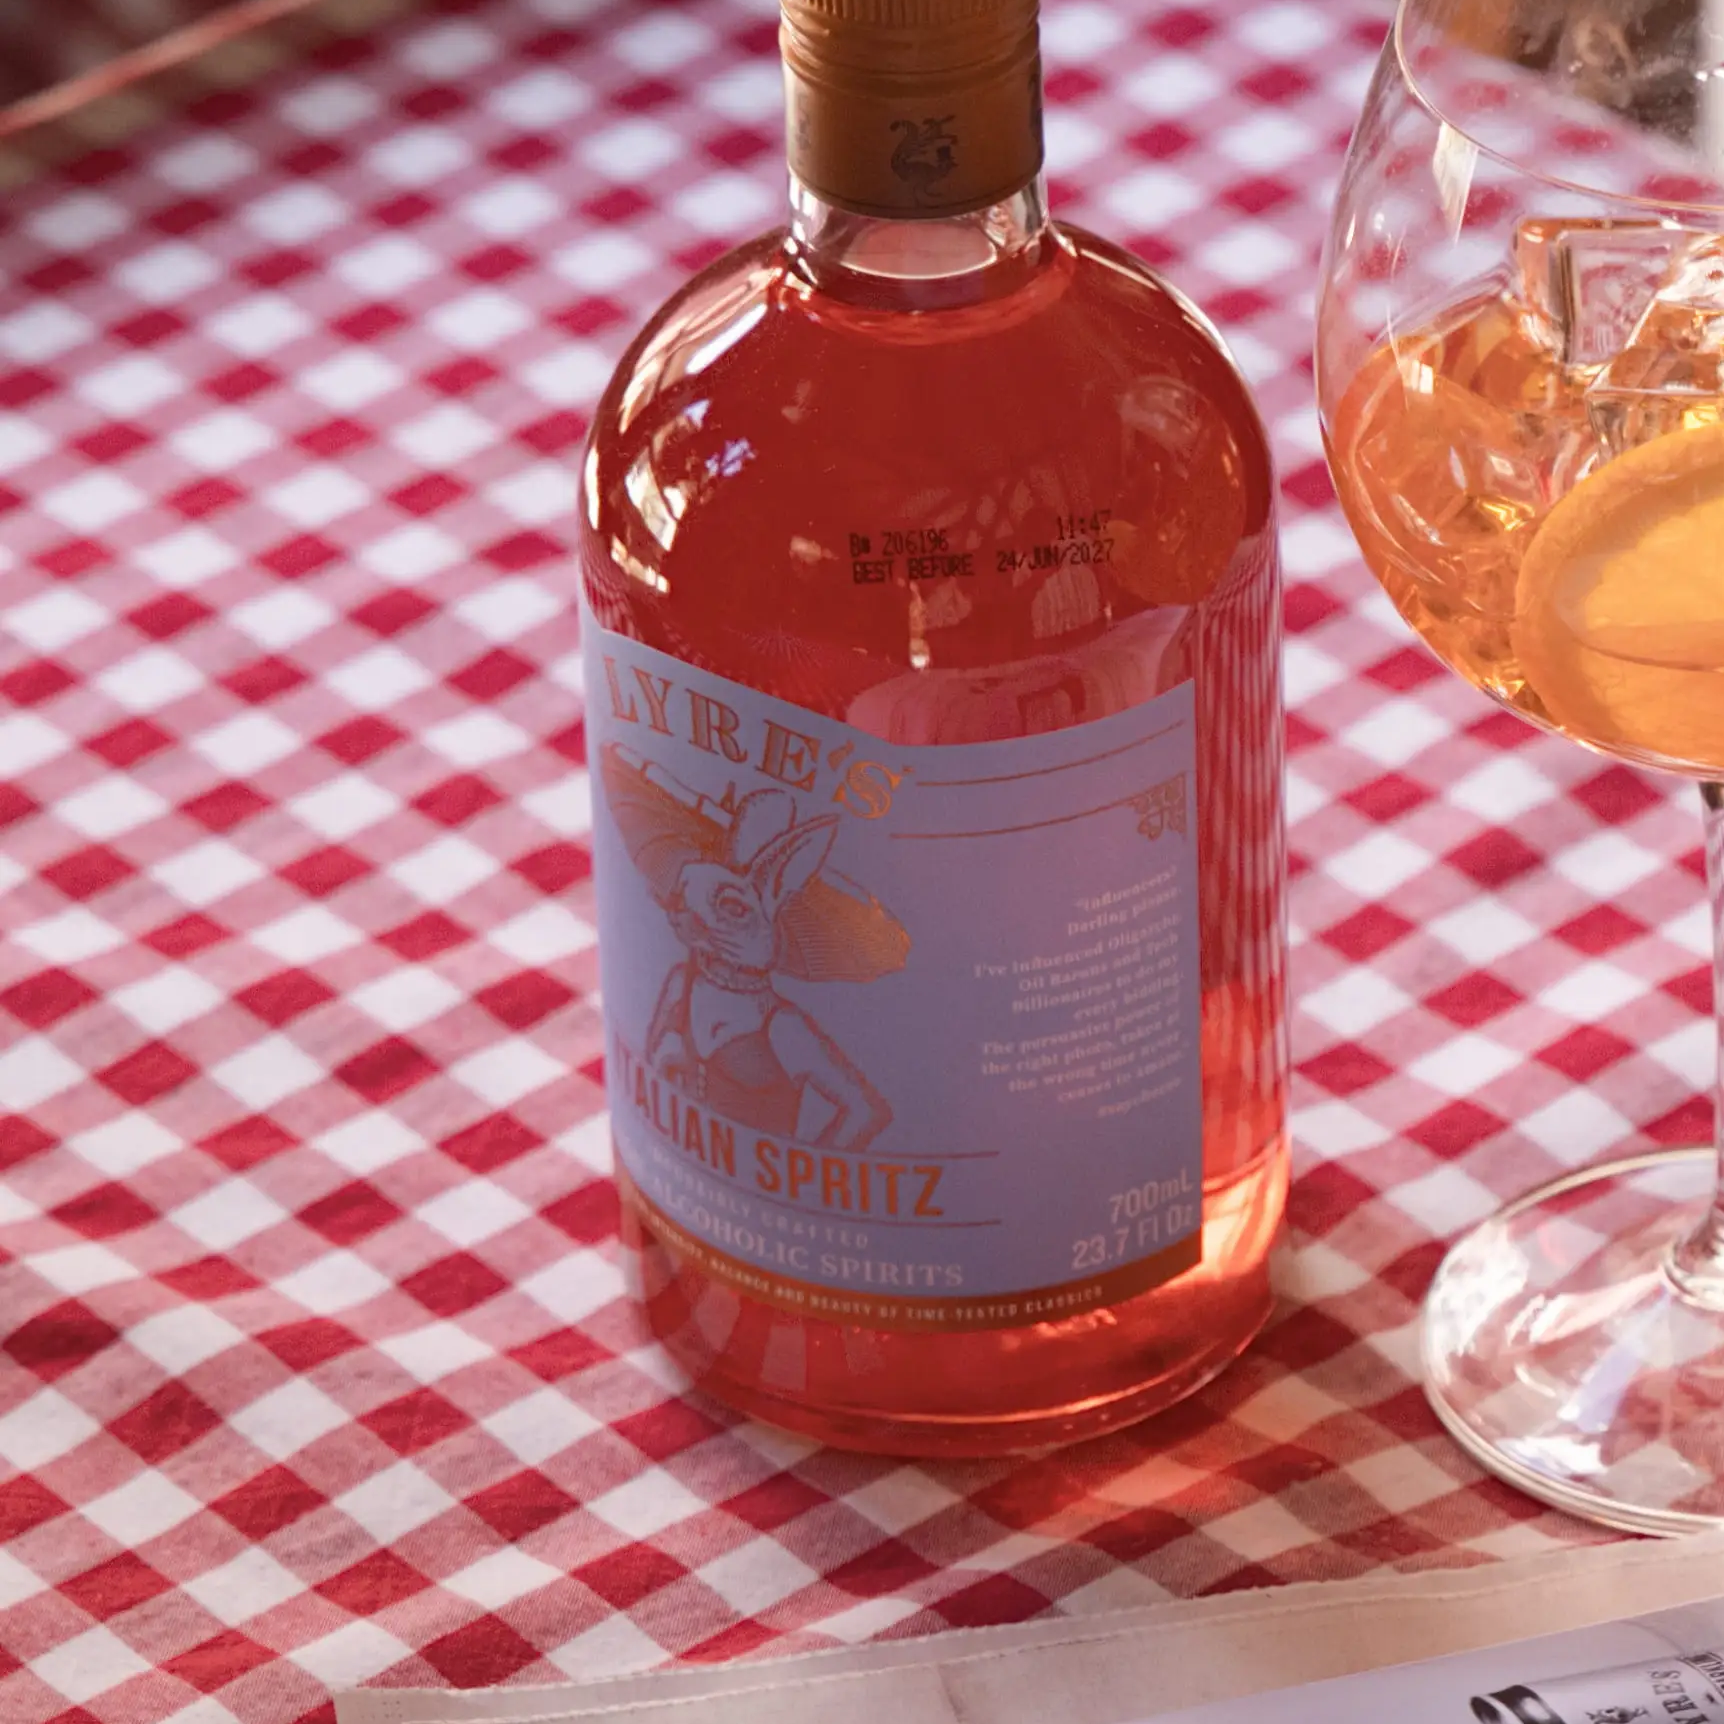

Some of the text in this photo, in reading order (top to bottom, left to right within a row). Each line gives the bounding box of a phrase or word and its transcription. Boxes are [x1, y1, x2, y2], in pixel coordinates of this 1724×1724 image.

[853, 560, 895, 585] BEST
[907, 553, 975, 580] BEFORE
[602, 654, 902, 821] LYRE'S
[755, 1139, 945, 1218] SPRITZ
[1108, 1166, 1195, 1224] 700mL
[819, 1252, 966, 1288] SPIRITS
[1071, 1226, 1130, 1271] 23.7
